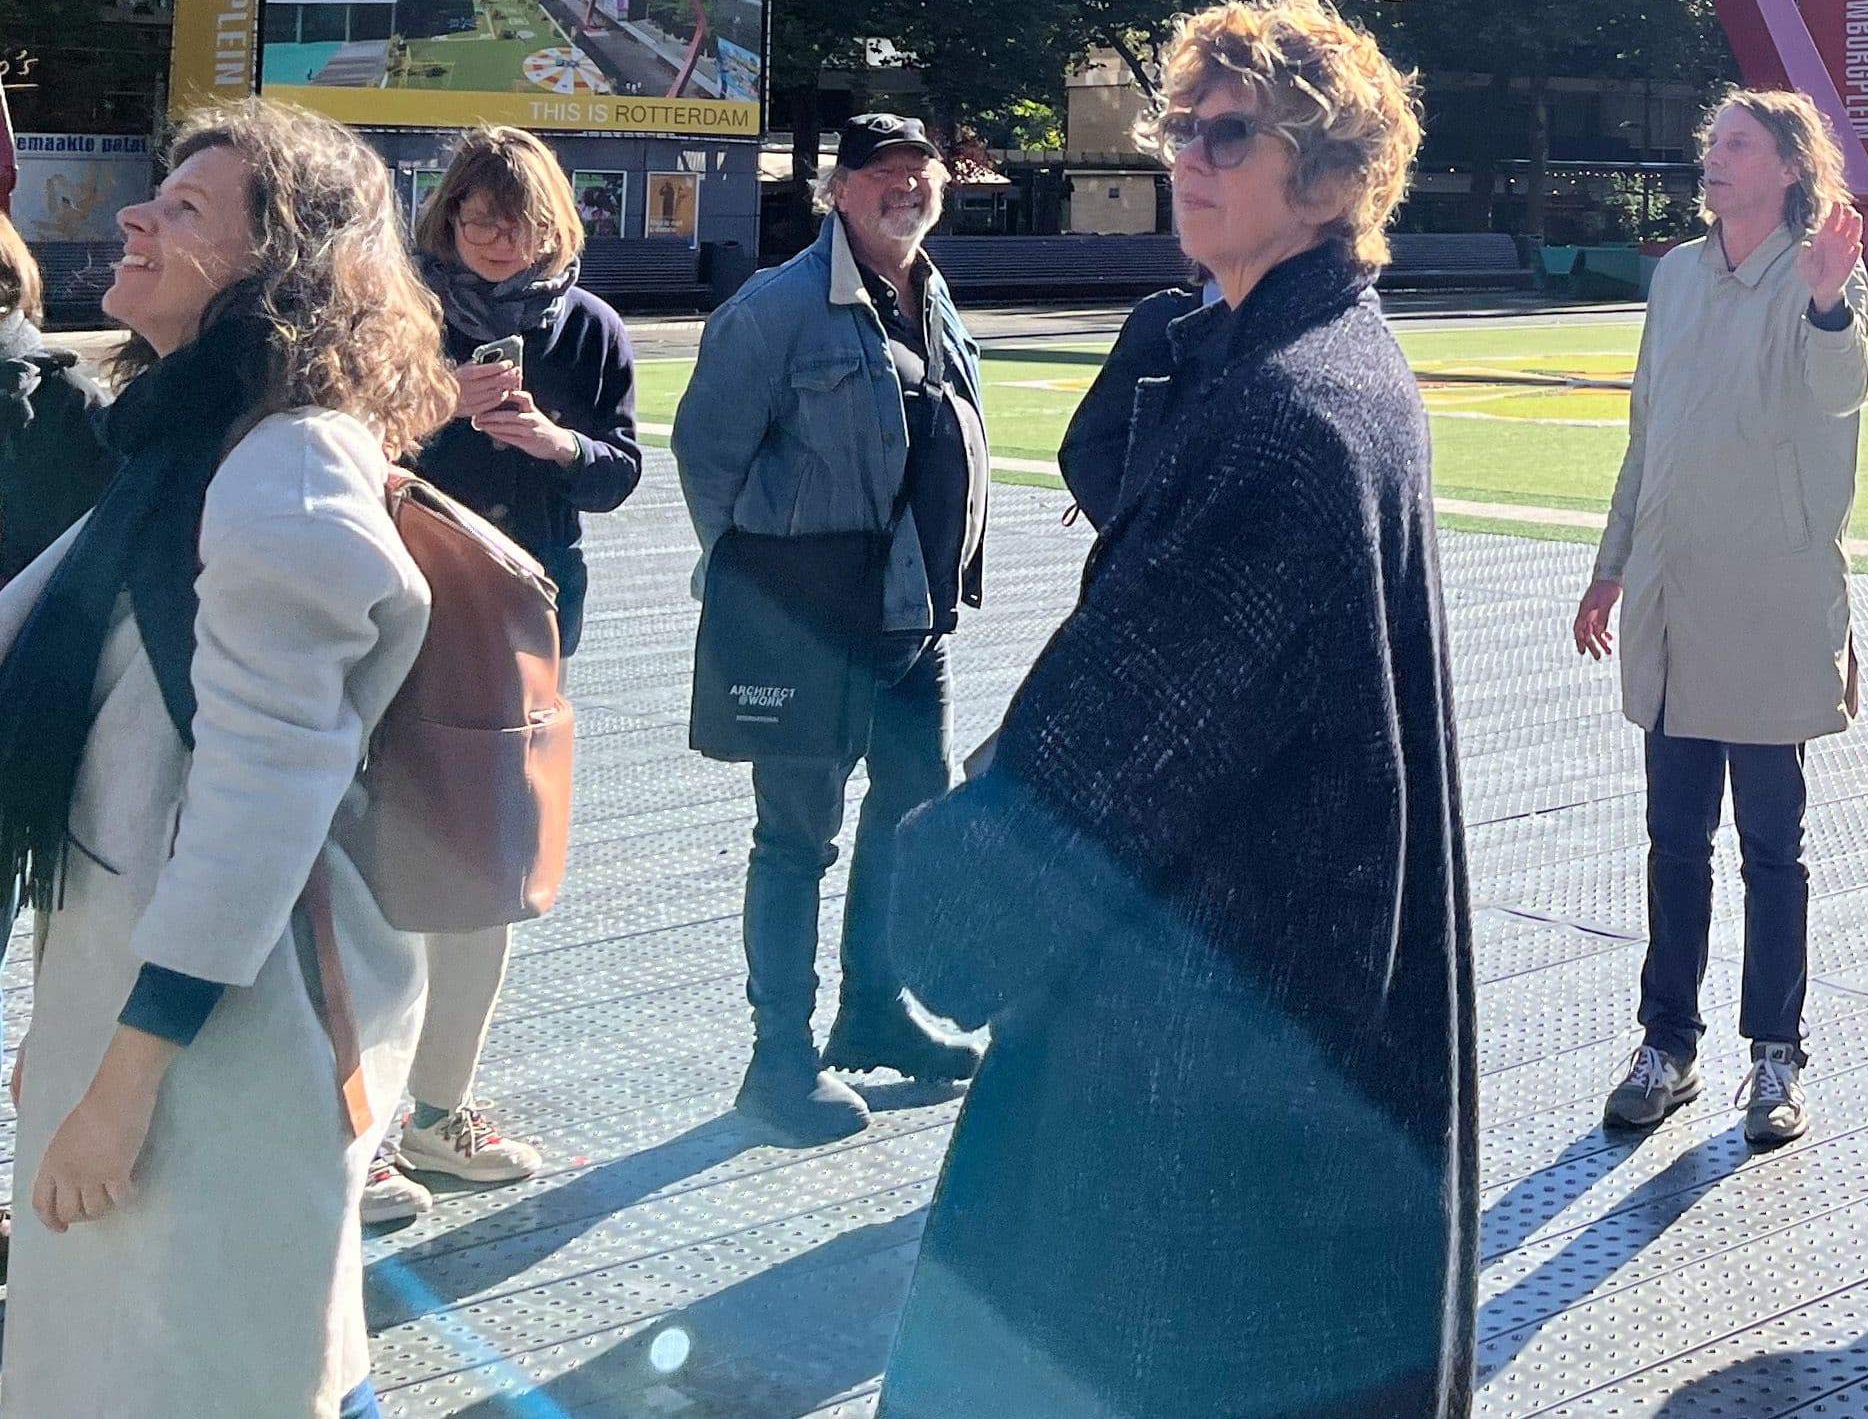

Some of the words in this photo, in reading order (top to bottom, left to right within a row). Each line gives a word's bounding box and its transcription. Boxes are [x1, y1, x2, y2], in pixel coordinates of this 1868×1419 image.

[529, 100, 582, 123] THIS
[587, 102, 609, 124] IS
[614, 103, 750, 128] ROTTERDAM
[729, 684, 796, 698] ARCHITECT
